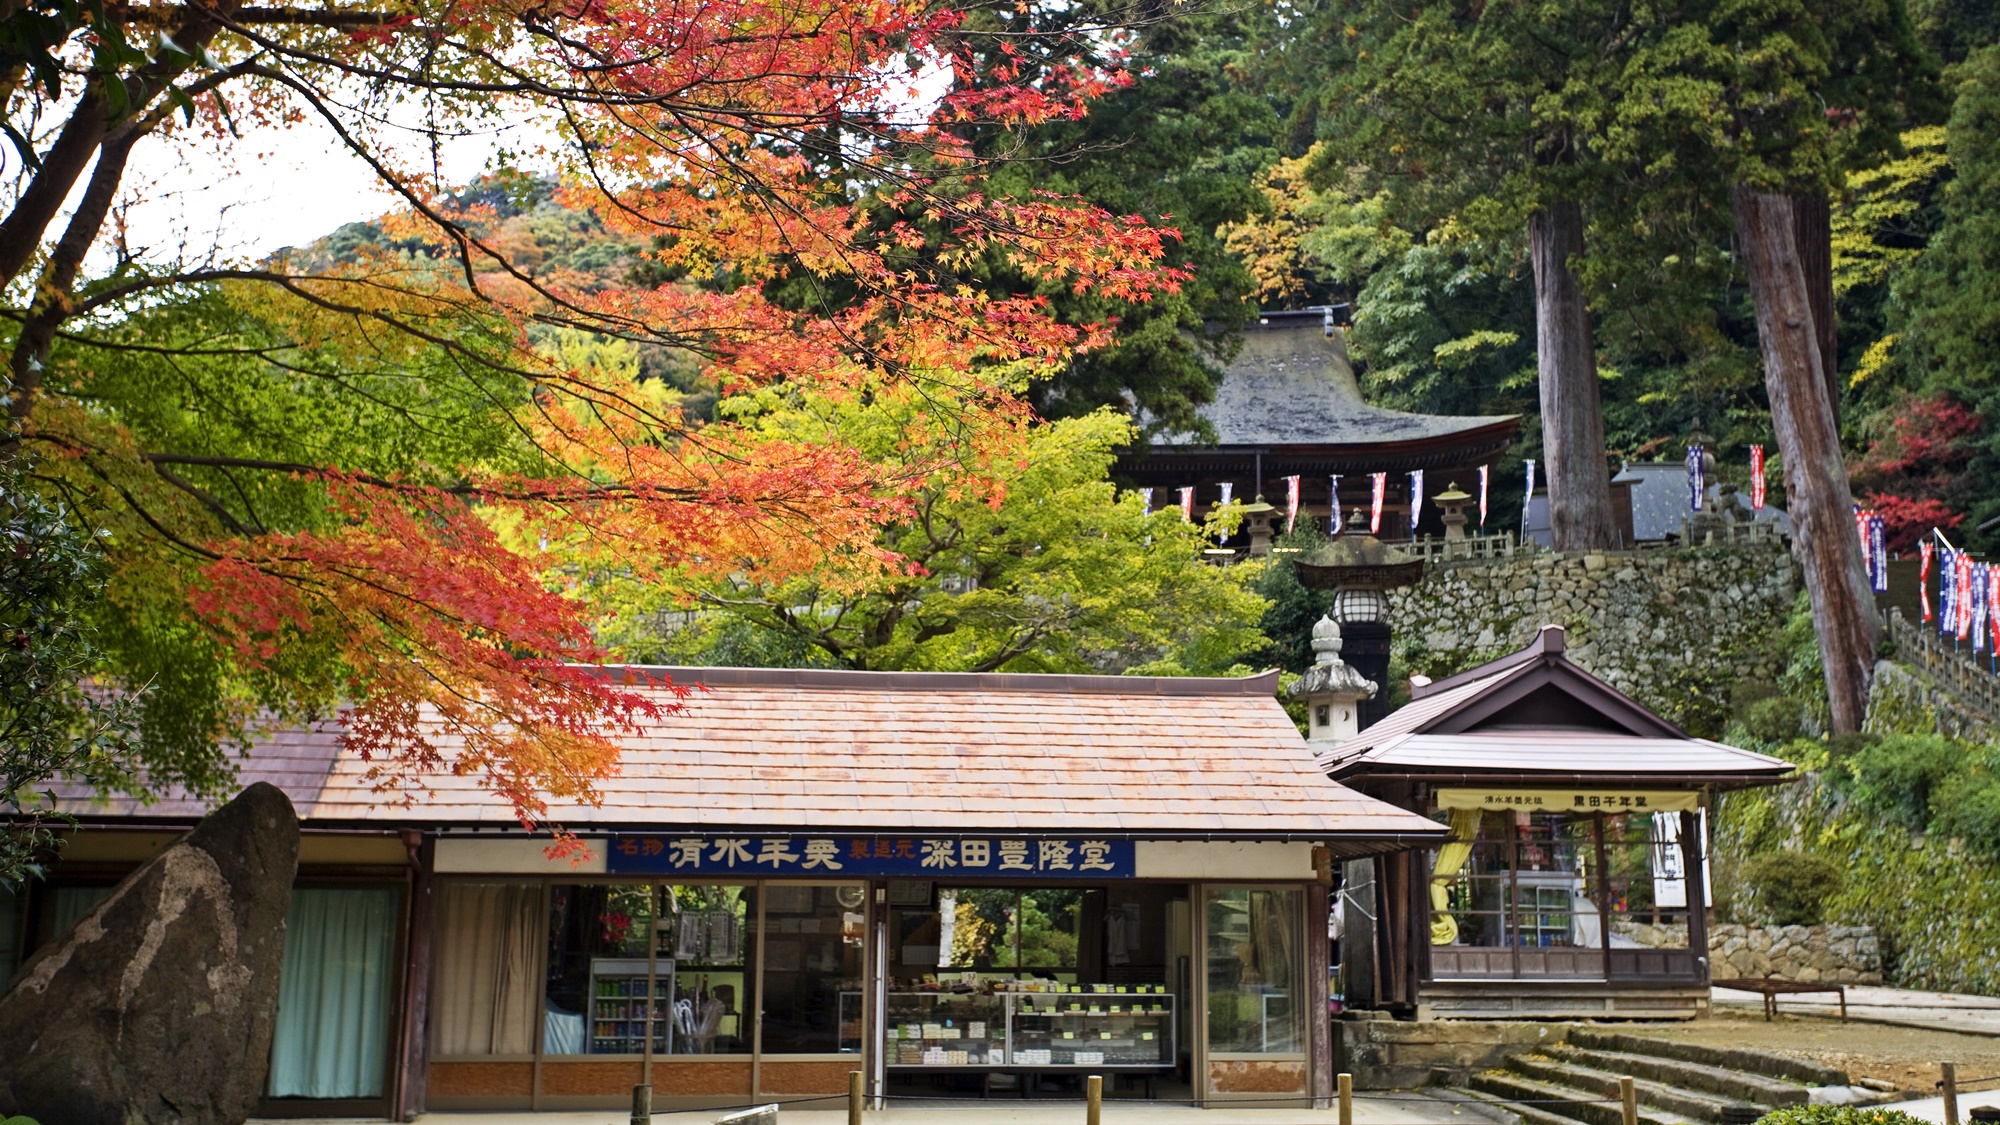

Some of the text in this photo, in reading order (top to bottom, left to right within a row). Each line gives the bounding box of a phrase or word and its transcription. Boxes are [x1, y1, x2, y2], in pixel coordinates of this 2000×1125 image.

[1573, 795, 1648, 808] 黒田千年堂
[848, 839, 916, 859] 製造元
